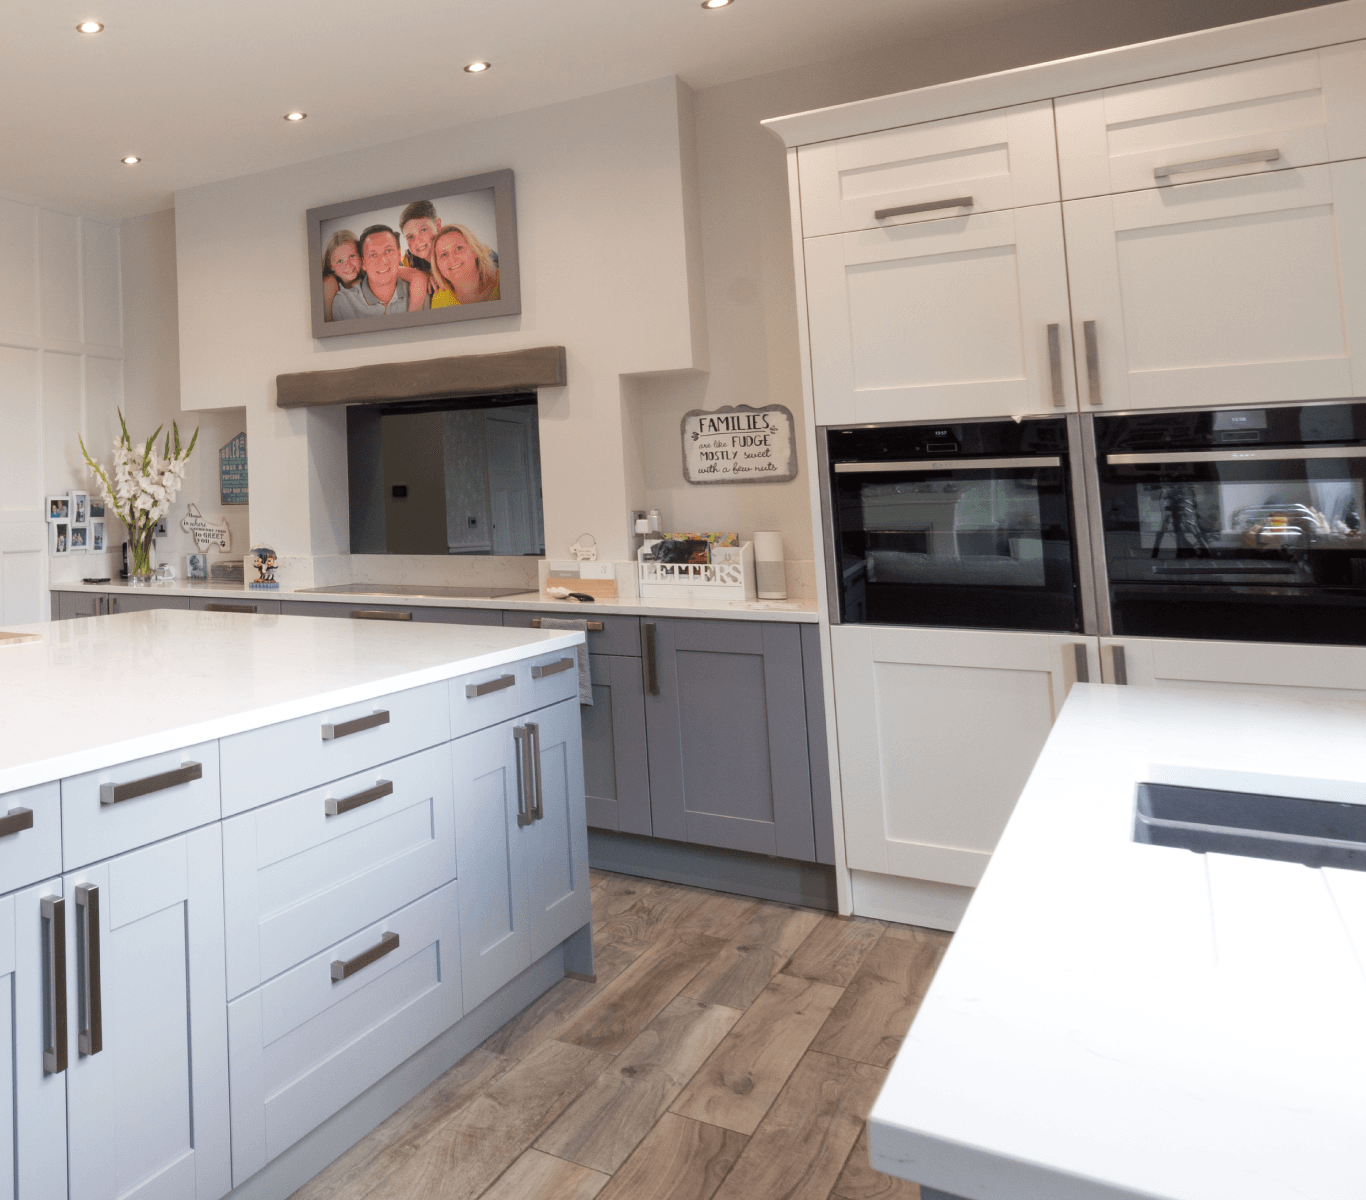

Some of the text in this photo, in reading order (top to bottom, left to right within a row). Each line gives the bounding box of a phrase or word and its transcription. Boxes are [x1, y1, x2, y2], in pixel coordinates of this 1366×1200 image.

[699, 413, 770, 432] FAMILIES
[714, 440, 727, 448] like
[732, 434, 771, 447] FUDGE
[700, 448, 771, 461] MOSTLY sweet
[698, 463, 720, 474] with
[733, 462, 752, 474] few
[755, 462, 778, 471] nuts
[190, 518, 206, 527] where
[642, 564, 741, 584] LETTERS
